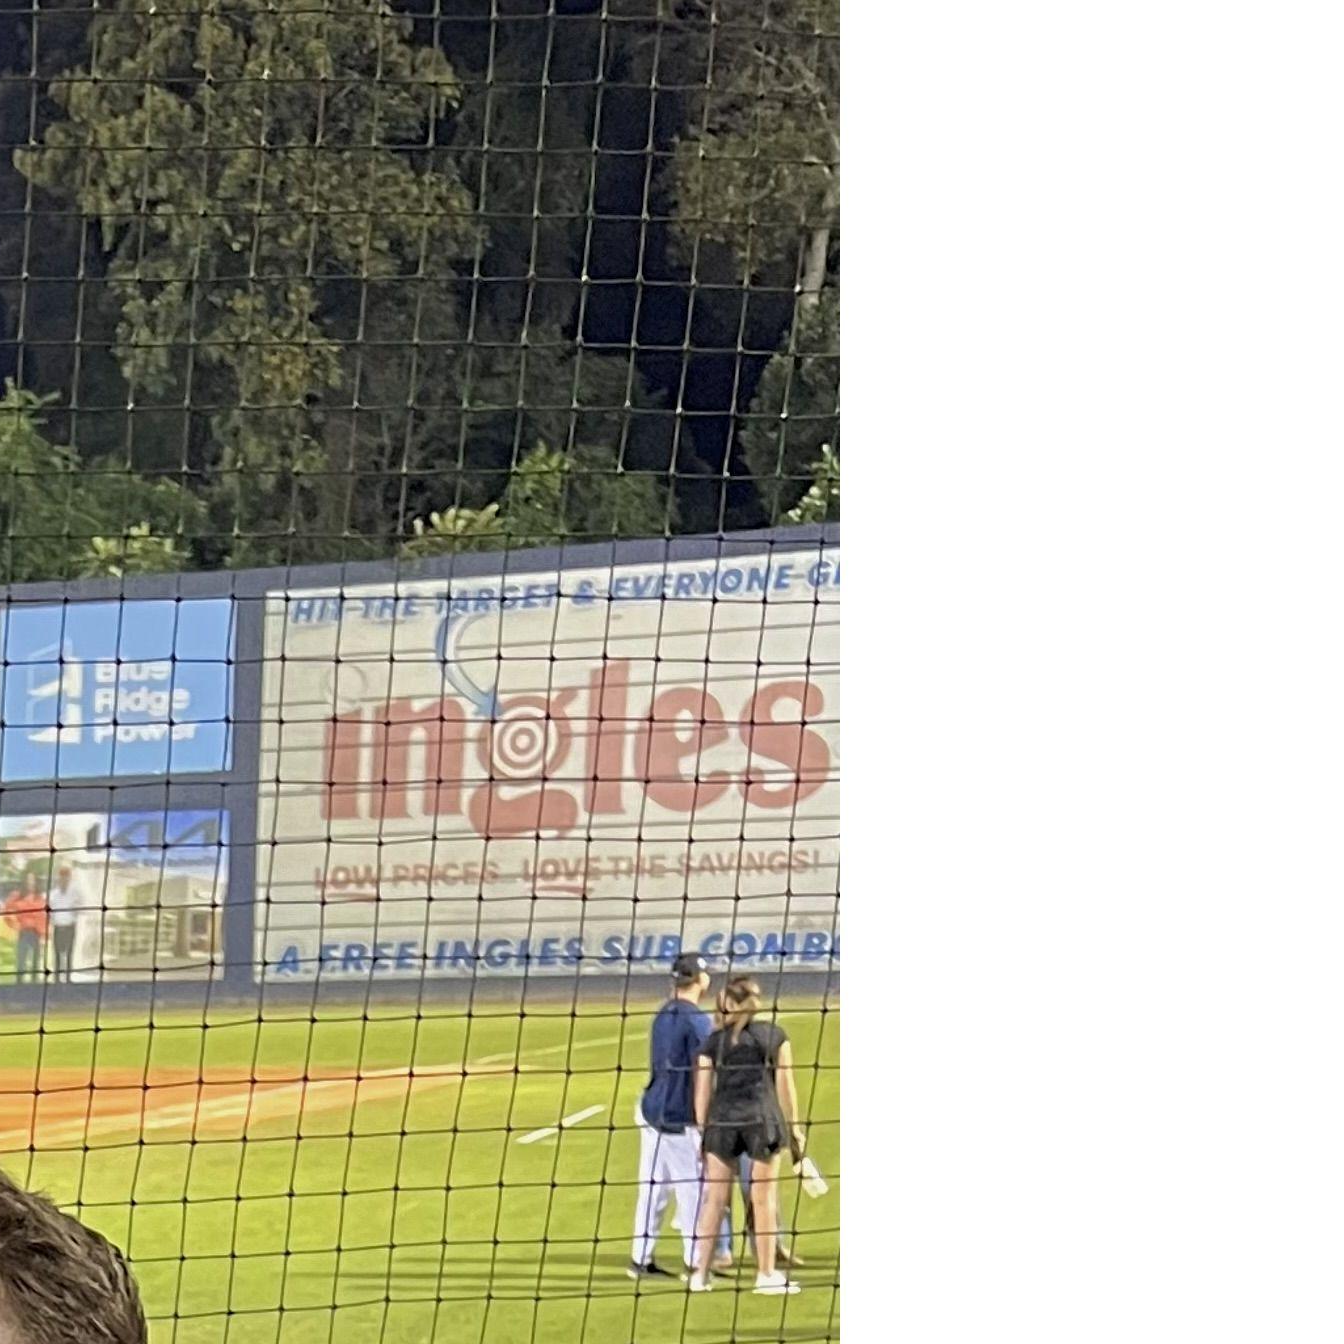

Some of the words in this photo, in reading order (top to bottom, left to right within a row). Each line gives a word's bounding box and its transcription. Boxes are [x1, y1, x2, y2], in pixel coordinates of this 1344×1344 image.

[362, 593, 420, 618] THE
[435, 583, 559, 617] TARGET
[613, 564, 794, 599] EVERYONE
[94, 657, 171, 682] Blue
[94, 685, 191, 716] Ridge
[94, 717, 198, 744] Power
[319, 657, 831, 840] ingles
[314, 863, 380, 889] LOW
[392, 860, 500, 887] PRICES
[523, 855, 602, 882] LOVE
[607, 854, 667, 879] THE
[677, 849, 821, 877] SAVINGS!
[276, 944, 300, 974] A
[321, 940, 418, 973] FREE
[433, 936, 584, 969] INGLES
[700, 932, 840, 963] COMB
